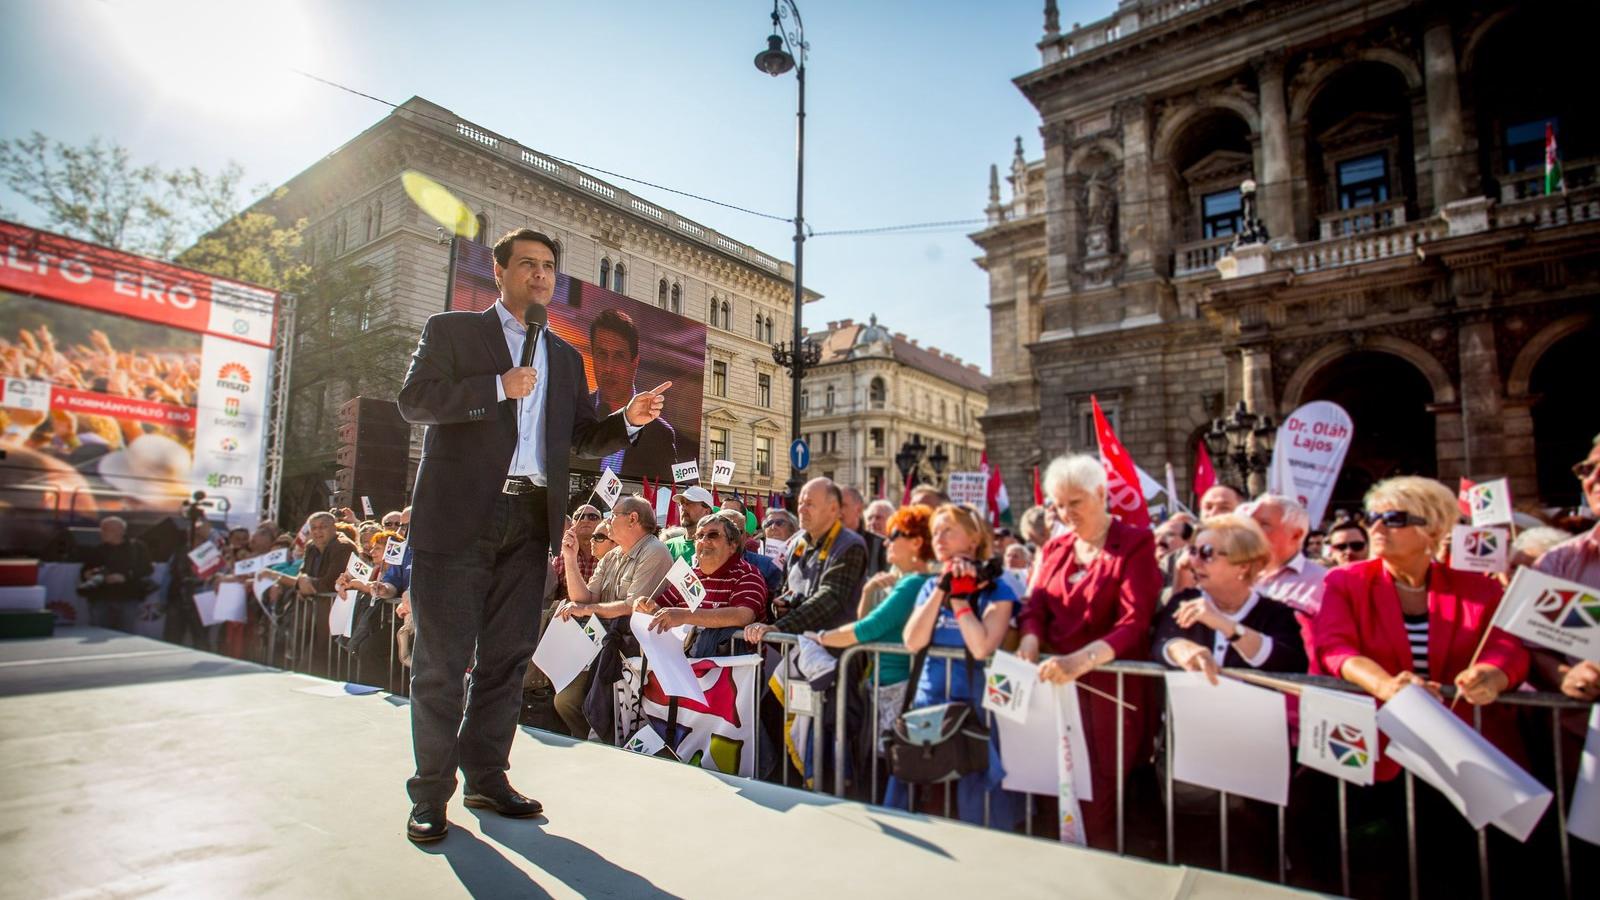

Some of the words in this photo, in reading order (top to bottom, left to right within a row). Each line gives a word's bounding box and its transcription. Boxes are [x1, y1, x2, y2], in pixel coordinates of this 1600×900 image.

[0, 244, 94, 283] LTÓ
[55, 394, 65, 404] A
[1288, 418, 1308, 433] Dr.
[1312, 421, 1348, 438] Oláh
[1293, 433, 1333, 453] Lajos
[682, 466, 697, 478] pm
[218, 474, 243, 488] pm
